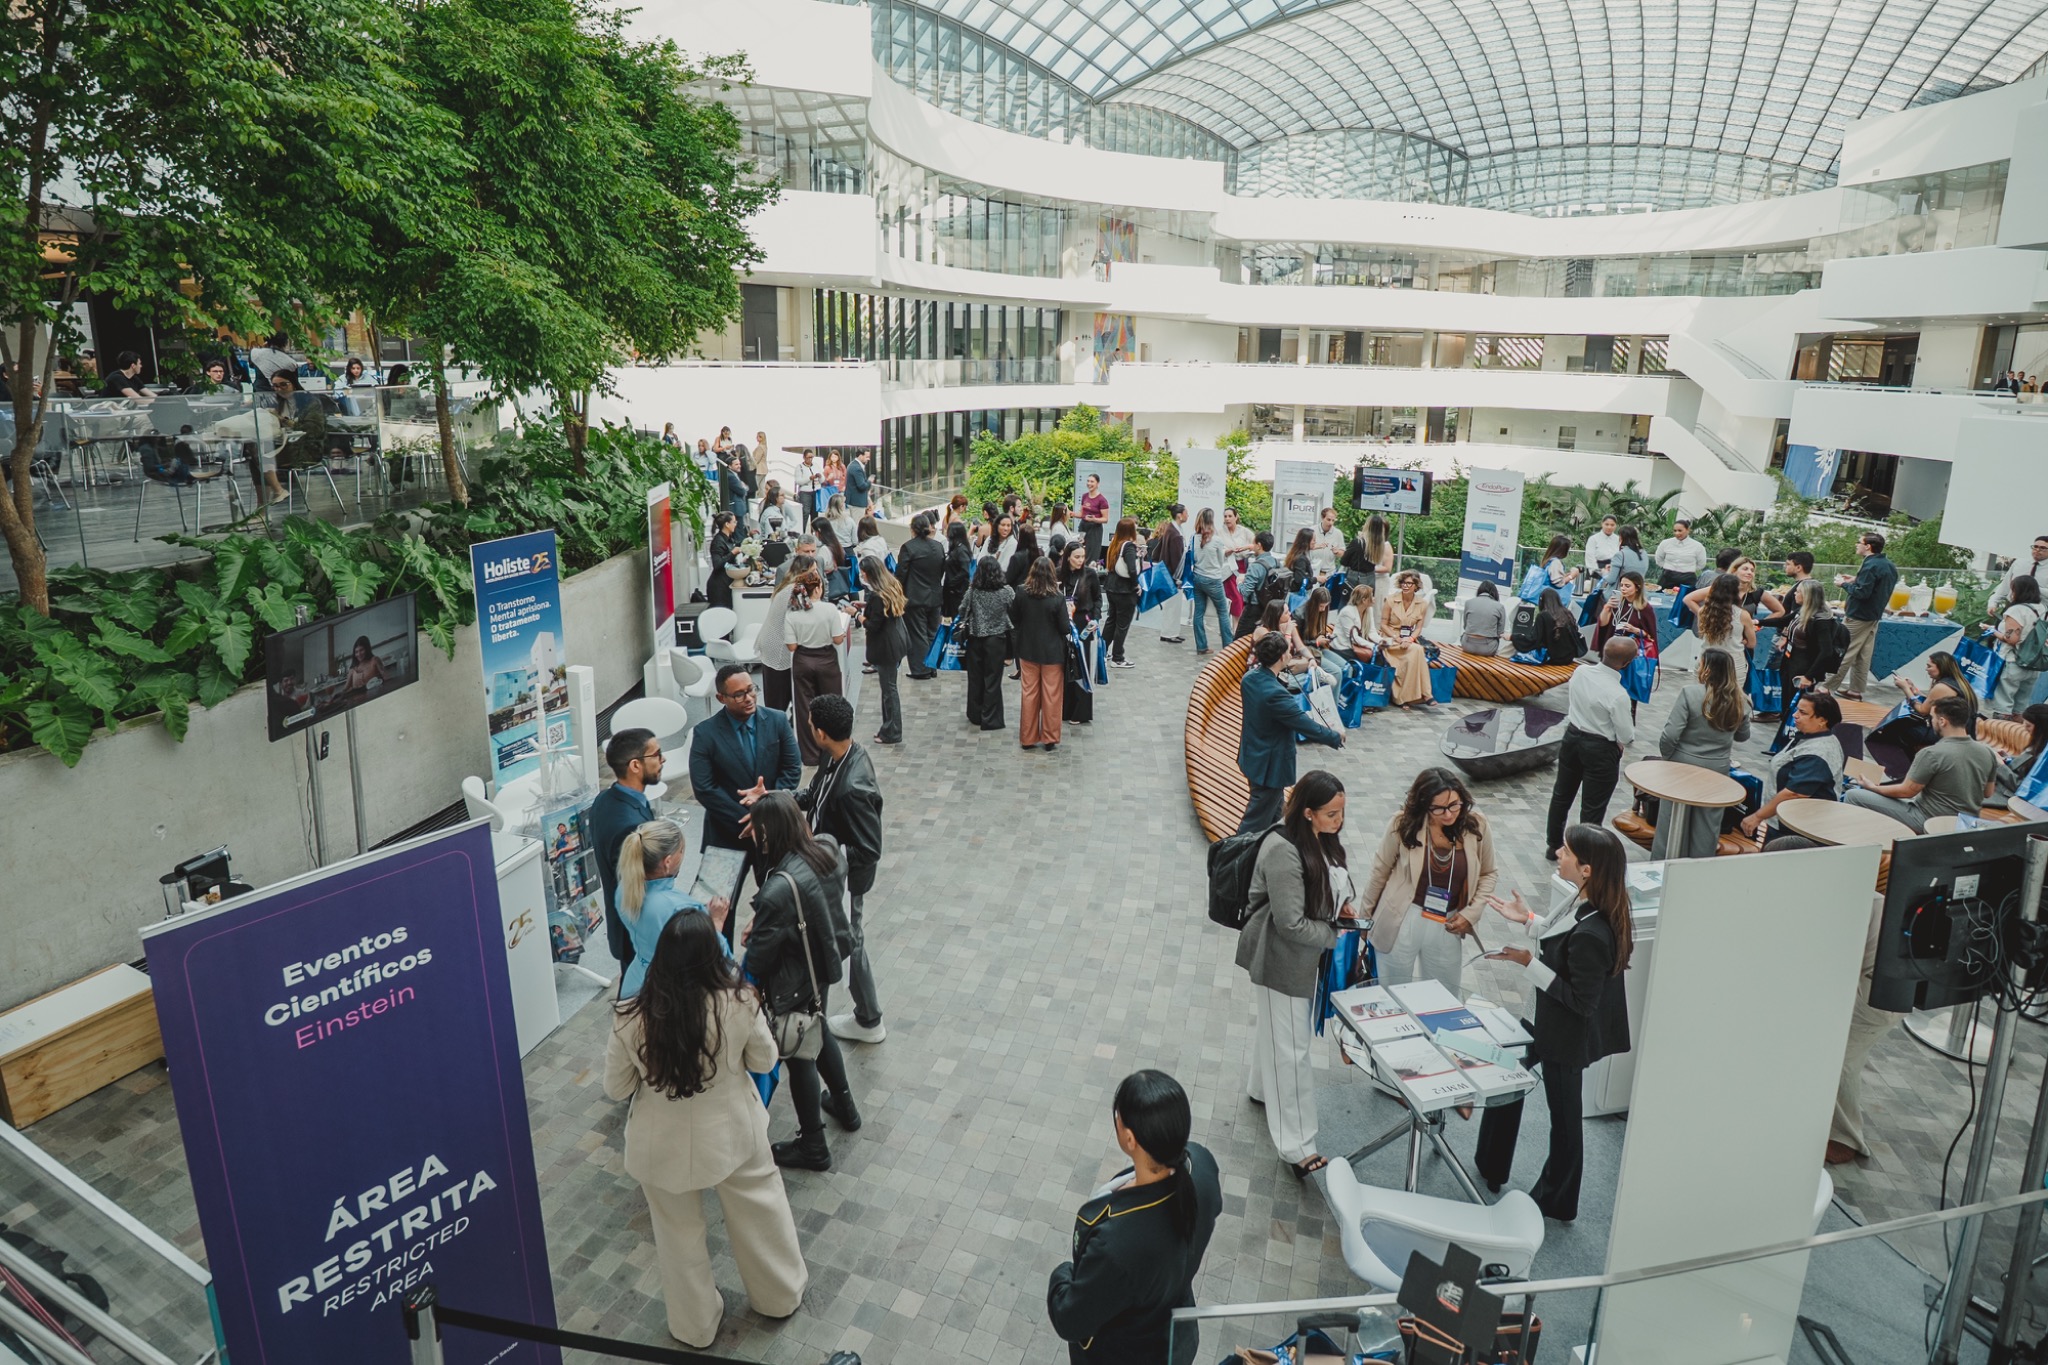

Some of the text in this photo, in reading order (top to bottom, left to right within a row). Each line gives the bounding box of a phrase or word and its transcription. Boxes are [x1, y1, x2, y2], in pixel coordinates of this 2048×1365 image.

[484, 557, 530, 579] Holiste
[489, 595, 536, 614] O Transtorno
[490, 601, 552, 624] Mental aprisiona.
[490, 613, 540, 633] O tratamento
[491, 629, 520, 643] liberta.
[282, 926, 408, 988] Eventos
[264, 948, 432, 1026] Científicos
[295, 985, 415, 1050] Einstein
[1432, 1083, 1469, 1094] WMT-2
[1500, 1071, 1528, 1081] SRS-2
[324, 1154, 449, 1243] ÁREA
[278, 1170, 498, 1314] RESTRITA
[323, 1216, 470, 1317] RESTRICTED
[370, 1261, 434, 1312] AREA
